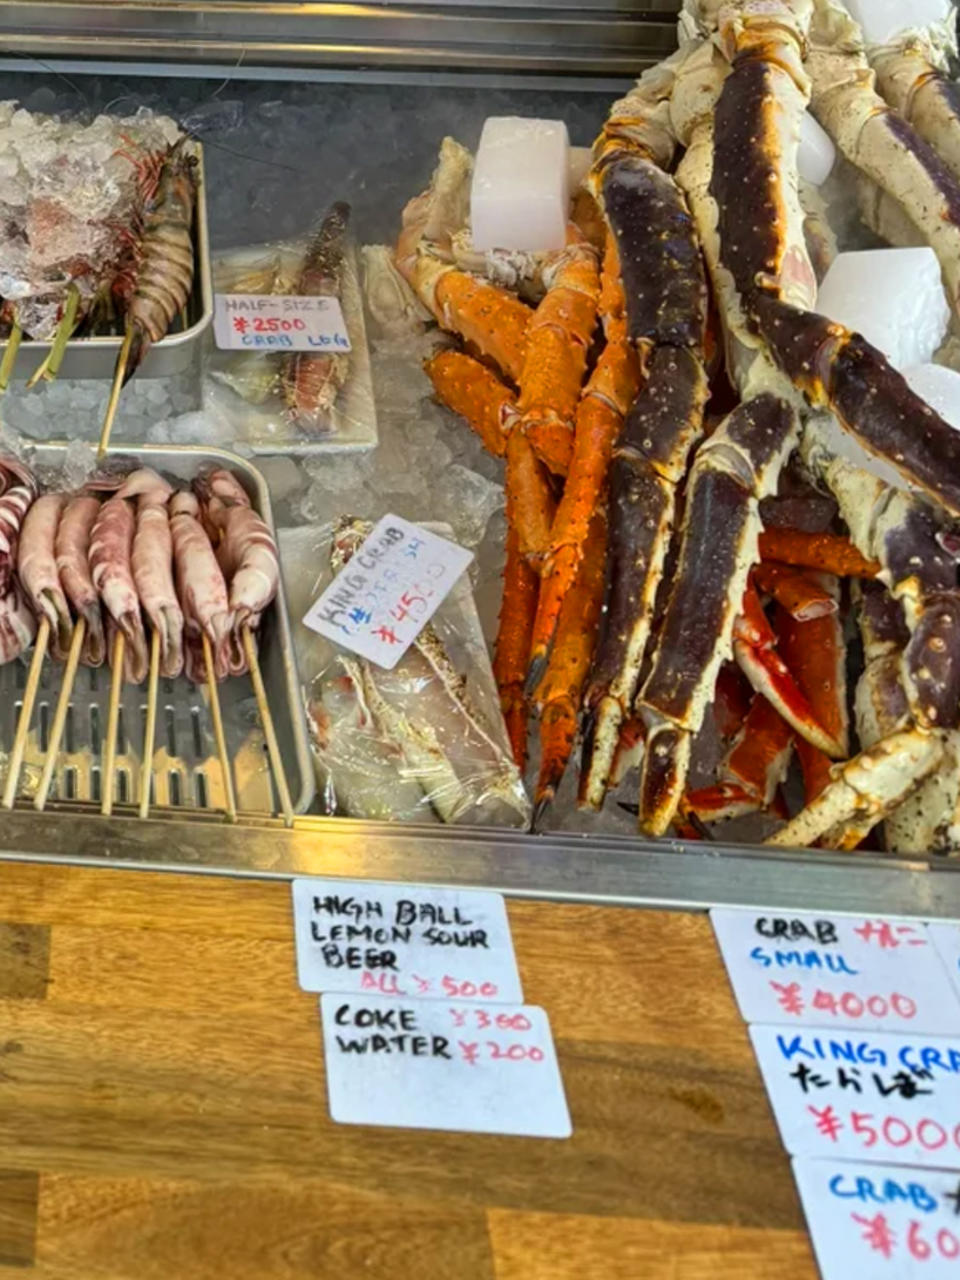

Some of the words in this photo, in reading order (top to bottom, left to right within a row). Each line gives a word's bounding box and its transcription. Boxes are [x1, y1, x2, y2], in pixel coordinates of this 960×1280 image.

[313, 895, 384, 922] HIGH
[395, 899, 473, 926] BALL
[310, 921, 412, 945] LEMON
[422, 928, 490, 950] SOUR
[754, 917, 839, 945] CRAB
[320, 944, 401, 971] BEER
[748, 946, 861, 976] SMALL
[769, 979, 918, 1019] ¥4000
[334, 1003, 417, 1031] COKE
[336, 1034, 453, 1060] WATER
[775, 1033, 888, 1068] KING
[807, 1103, 960, 1151] ¥500
[828, 1172, 939, 1214] CRAB
